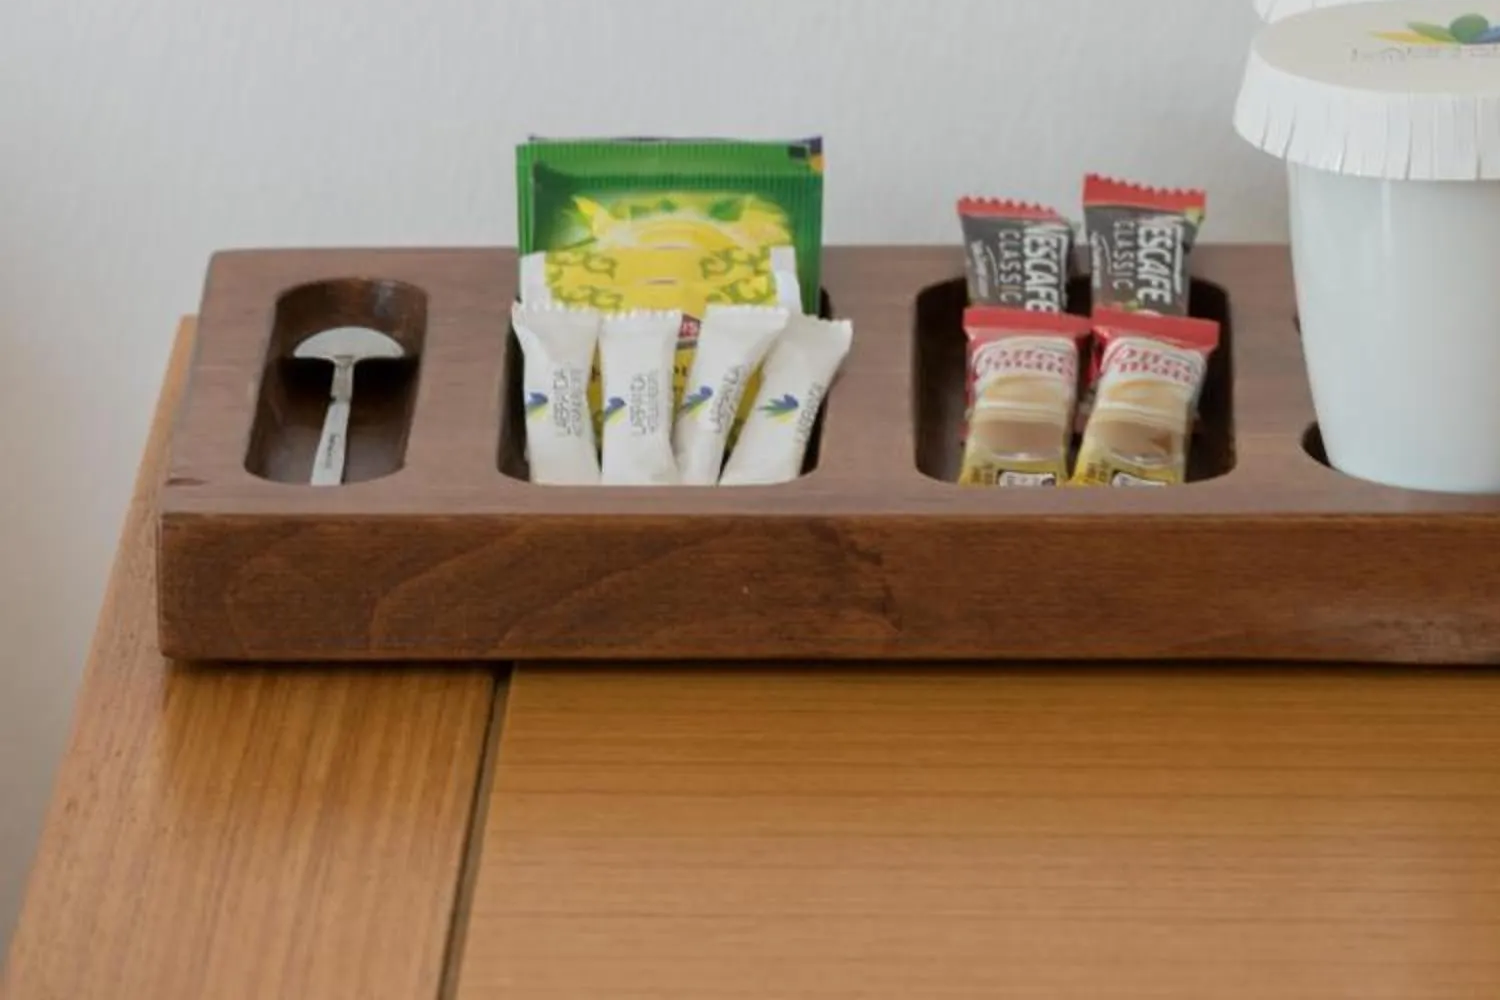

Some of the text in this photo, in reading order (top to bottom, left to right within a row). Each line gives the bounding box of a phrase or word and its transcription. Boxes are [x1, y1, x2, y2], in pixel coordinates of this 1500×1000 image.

[998, 227, 1023, 303] CLASSIC
[1112, 220, 1135, 290] CLASSIC
[1137, 214, 1184, 306] ESCAFE
